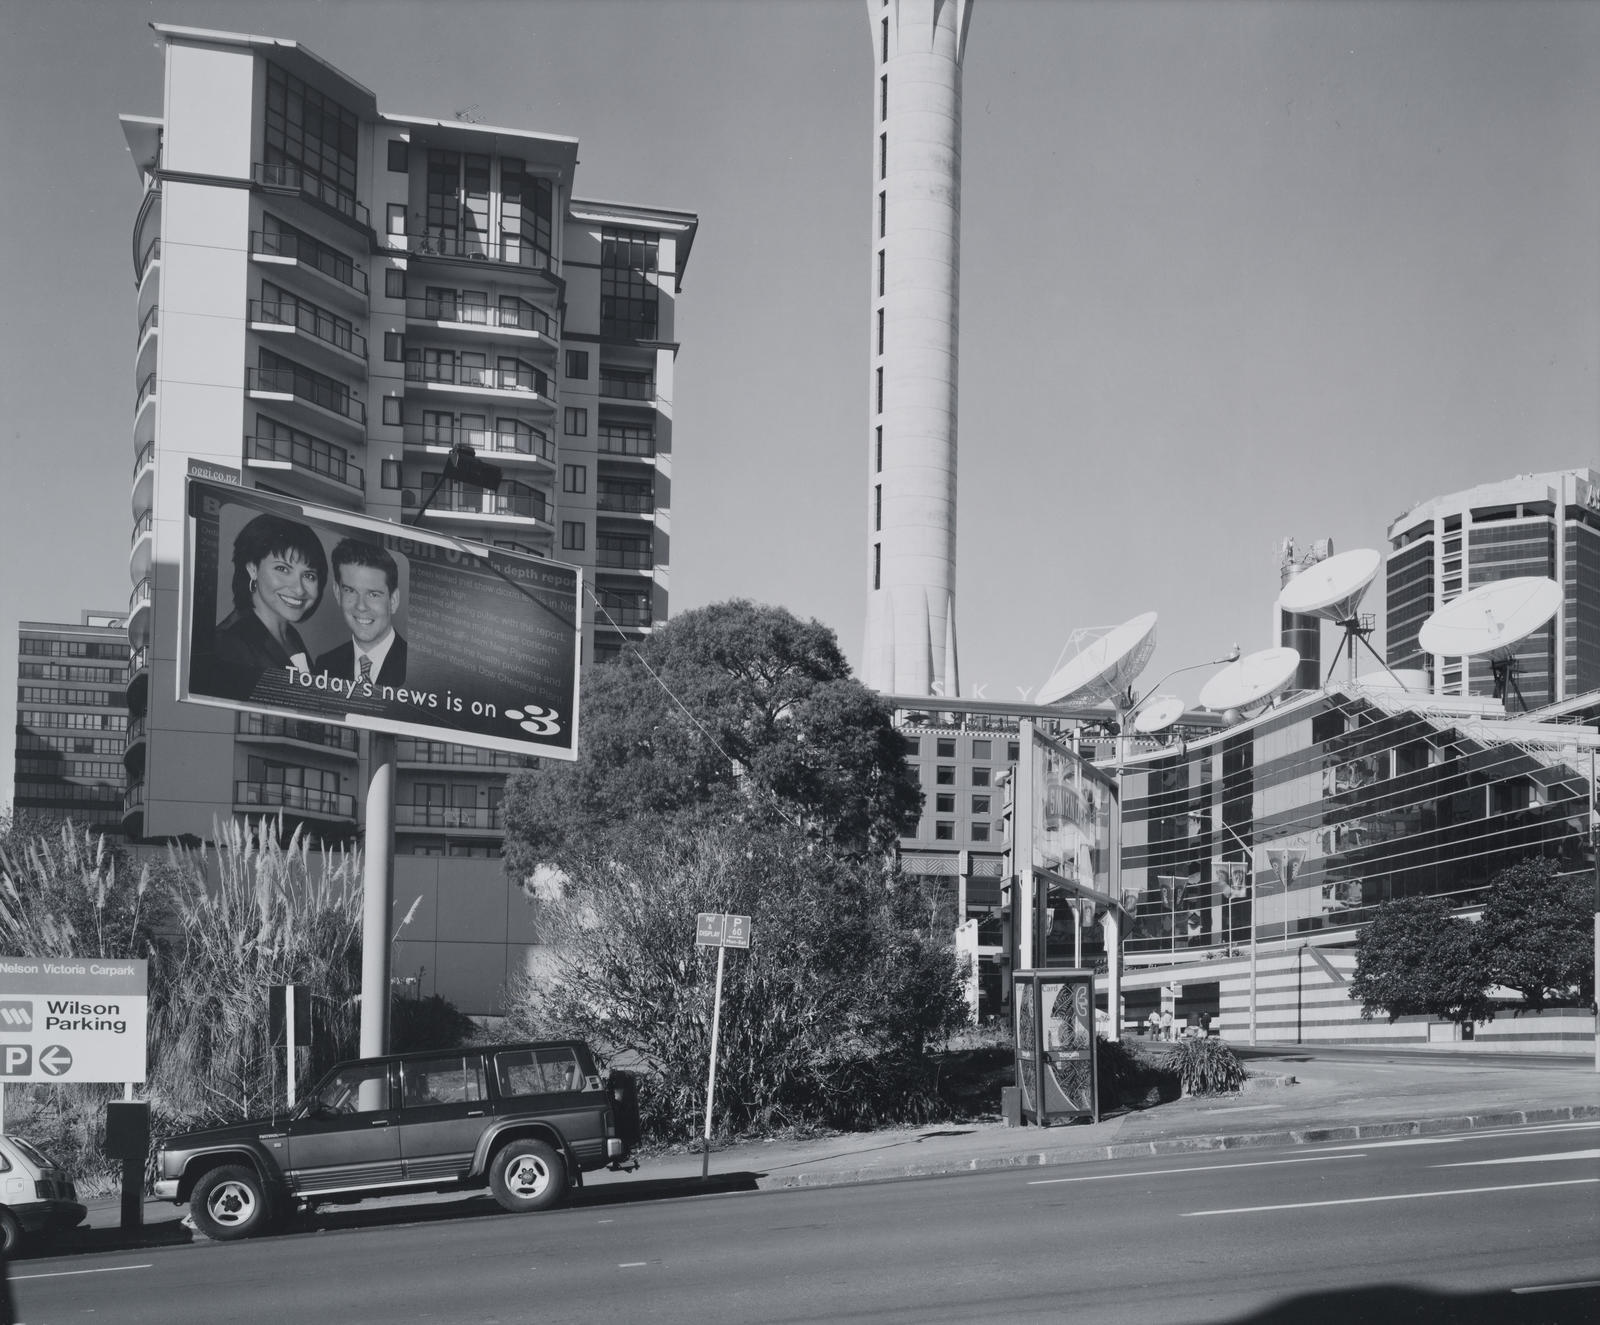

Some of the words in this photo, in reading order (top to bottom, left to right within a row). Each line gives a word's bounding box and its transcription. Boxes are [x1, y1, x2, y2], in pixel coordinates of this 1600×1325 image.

[191, 466, 238, 485] oggi.co.nz
[504, 564, 538, 580] depth
[509, 647, 550, 668] Plymouth
[285, 664, 373, 699] Today's
[382, 685, 438, 708] news
[446, 690, 463, 712] is
[471, 700, 497, 718] on
[734, 918, 742, 927] P
[732, 928, 742, 936] 60
[0, 963, 38, 974] Nelson
[43, 963, 86, 975] Victoria
[90, 964, 135, 977] Carpark
[47, 1000, 120, 1015] Wilson
[46, 1016, 127, 1034] Parking
[5, 1047, 28, 1074] P
